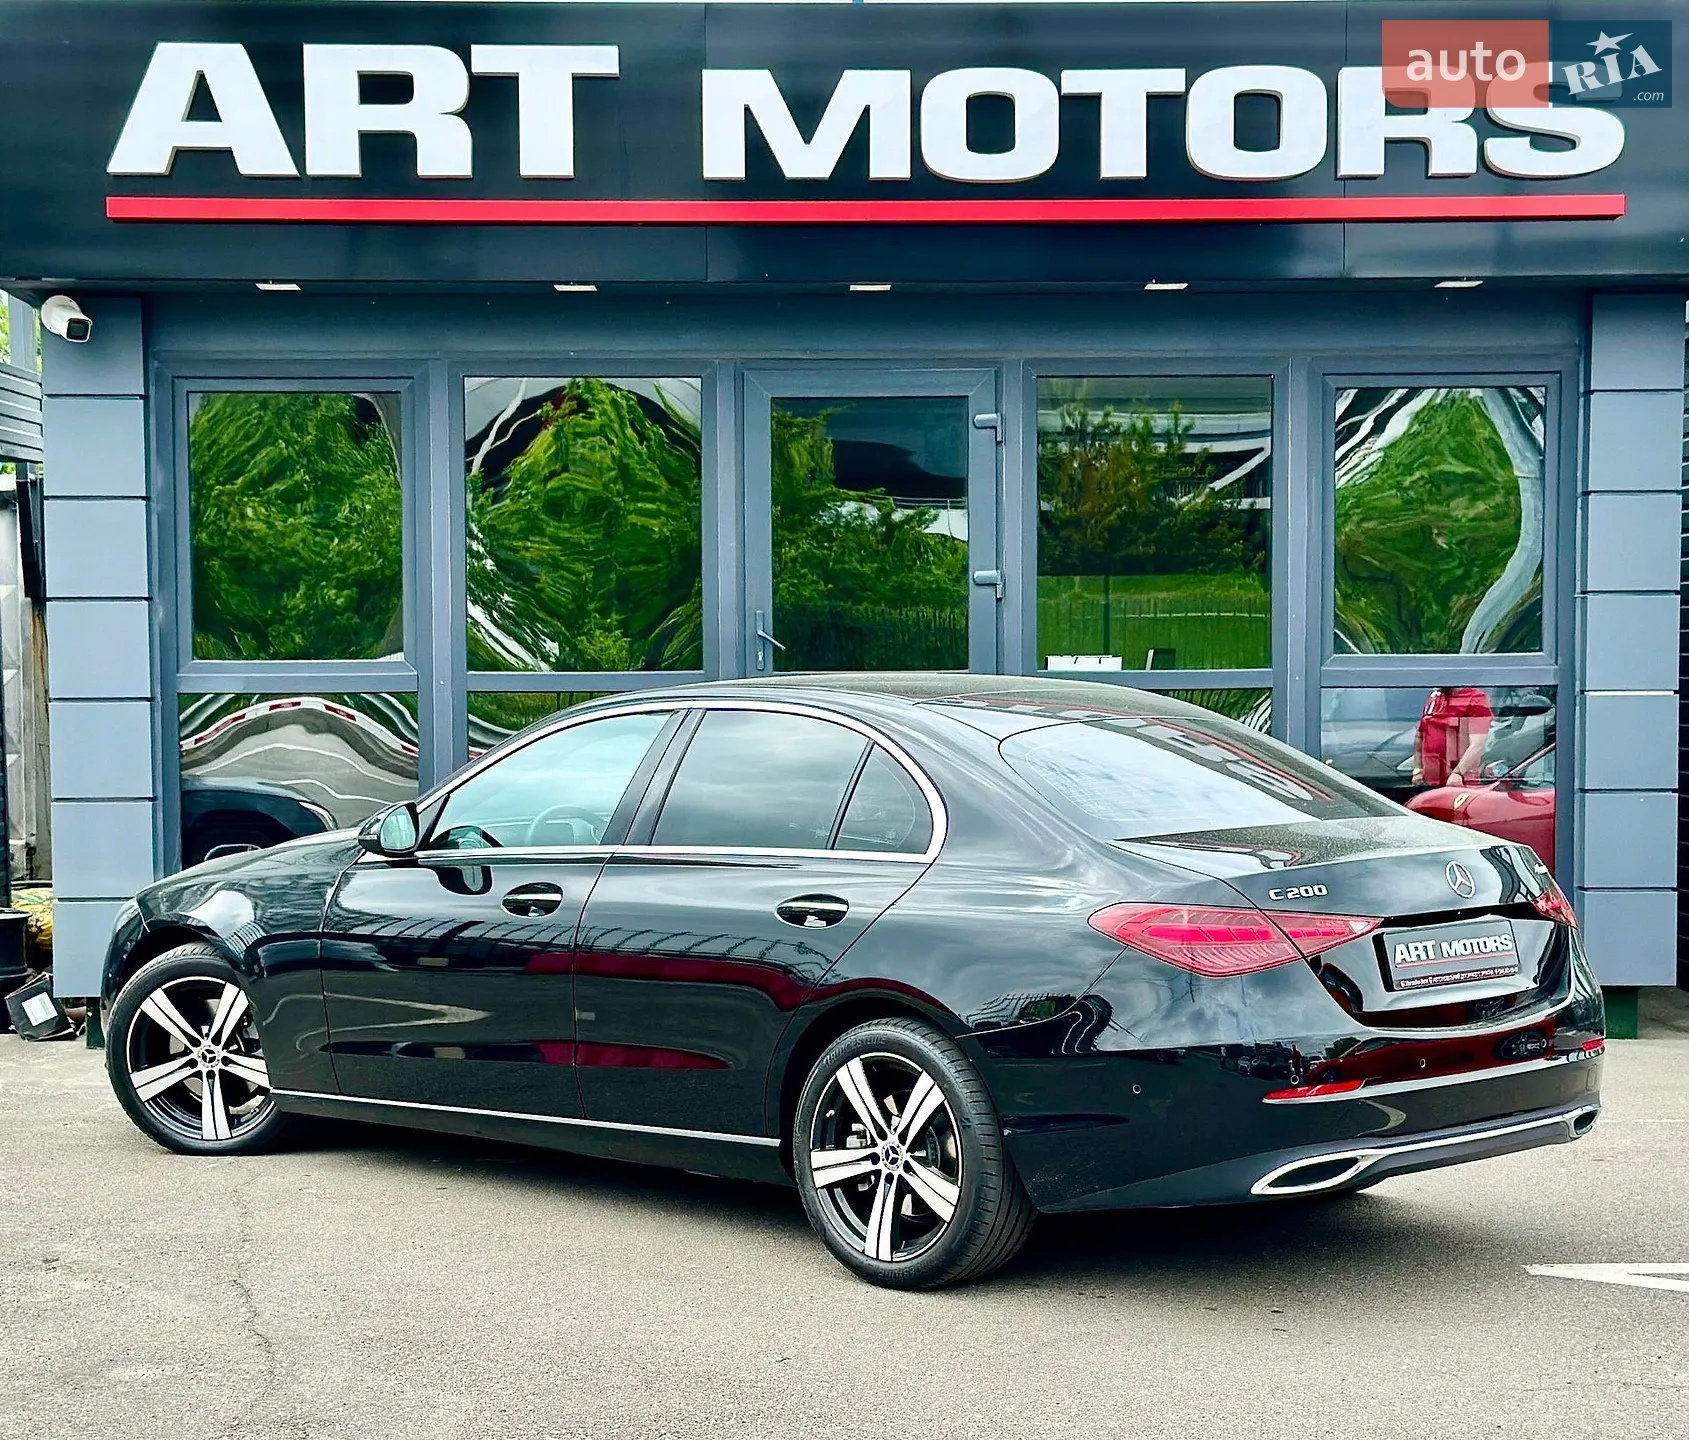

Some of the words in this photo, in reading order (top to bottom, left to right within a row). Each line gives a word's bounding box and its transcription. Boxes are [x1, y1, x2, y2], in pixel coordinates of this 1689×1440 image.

[106, 42, 620, 179] ART
[702, 63, 1626, 182] MOTORS
[1268, 889, 1285, 901] C
[1285, 884, 1328, 900] 200
[1394, 940, 1437, 964] ART
[1440, 933, 1513, 959] MOTORS
